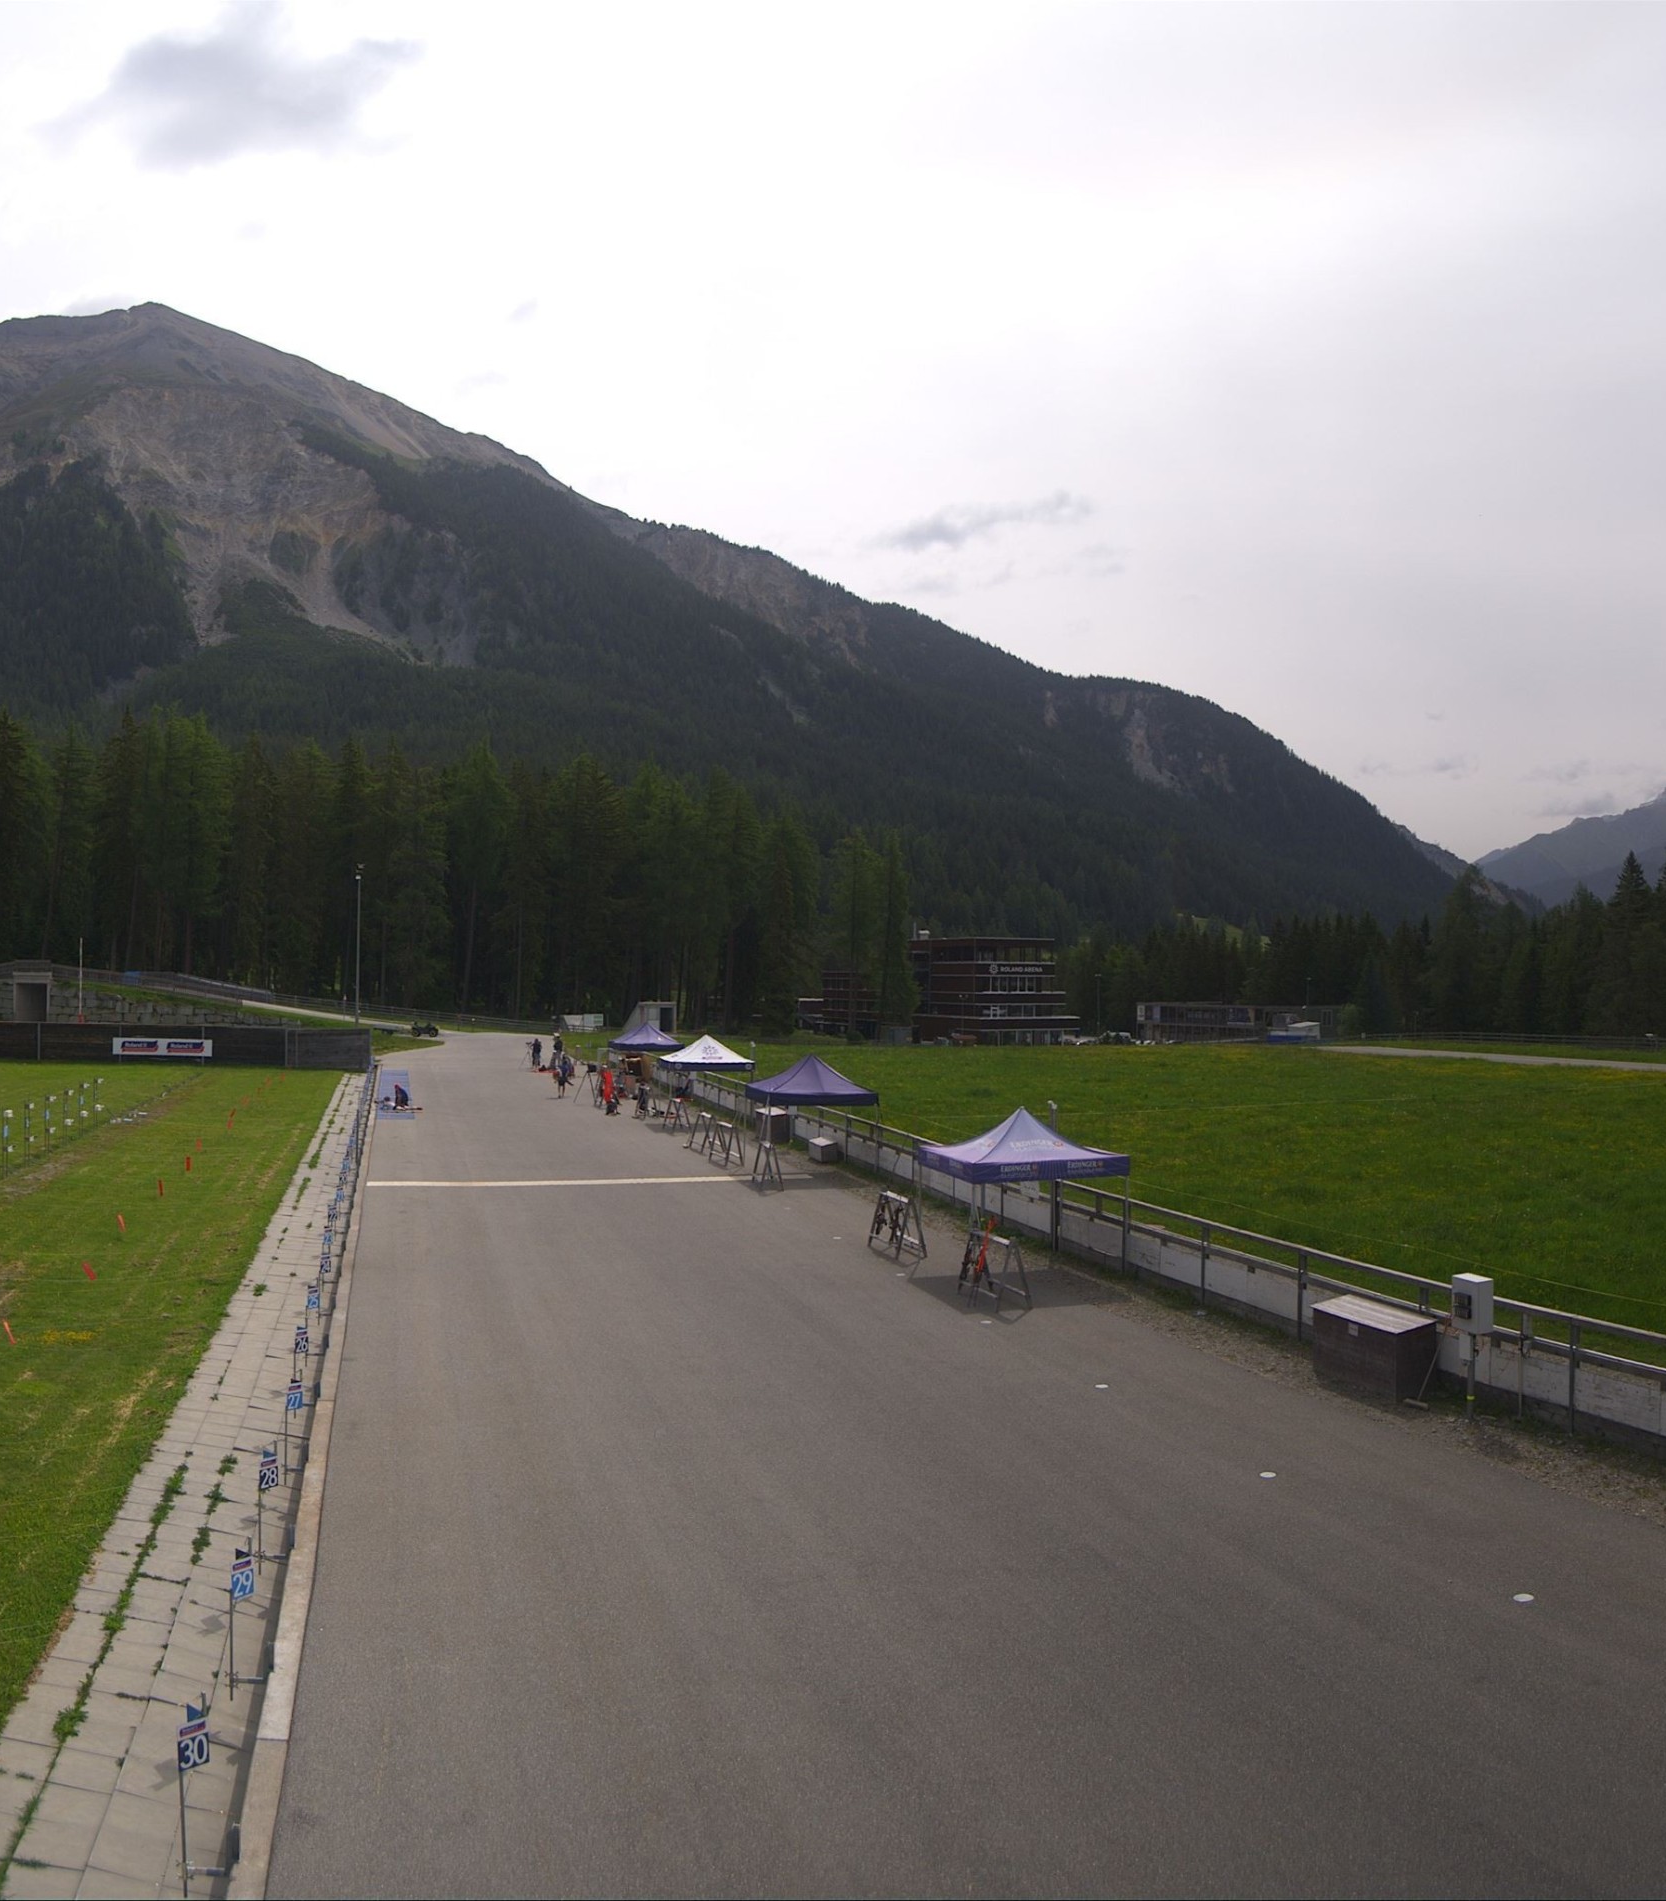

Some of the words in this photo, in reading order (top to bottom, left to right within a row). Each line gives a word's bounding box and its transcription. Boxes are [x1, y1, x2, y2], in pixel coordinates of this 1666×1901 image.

[296, 1338, 307, 1352] 26
[288, 1394, 301, 1410] 27
[260, 1468, 278, 1489] 28
[233, 1570, 253, 1597] 29
[180, 1734, 208, 1769] 30
